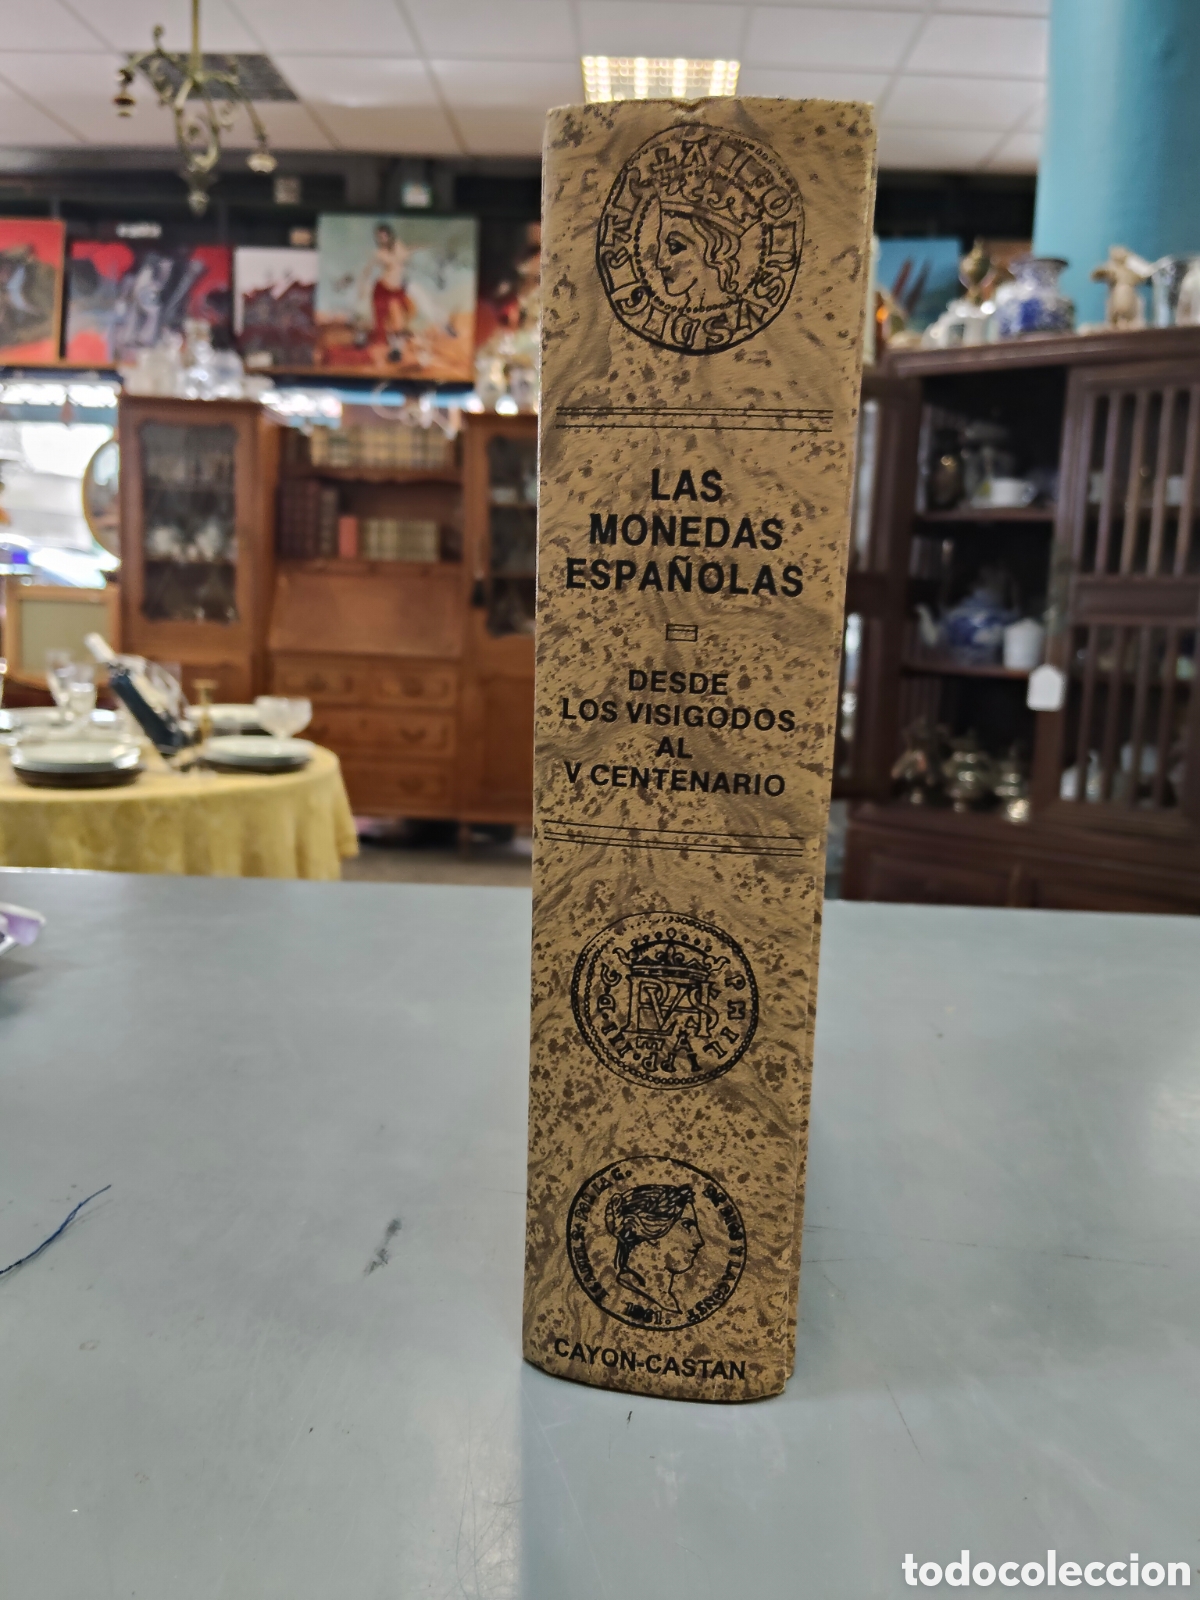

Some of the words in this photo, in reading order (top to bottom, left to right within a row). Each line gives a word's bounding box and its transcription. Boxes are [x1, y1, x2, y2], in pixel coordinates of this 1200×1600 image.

[650, 468, 723, 502] LAS
[589, 513, 784, 551] MONEDAS
[565, 555, 804, 597] ESPAÑOLAS
[628, 669, 729, 696] DESDE
[562, 697, 618, 723] LOS
[626, 703, 796, 732] VISIGODOS
[655, 736, 693, 759] AL
[564, 761, 582, 784] V
[590, 764, 786, 797] CENTENARIO
[554, 1337, 747, 1380] CAYON-CASTAN
